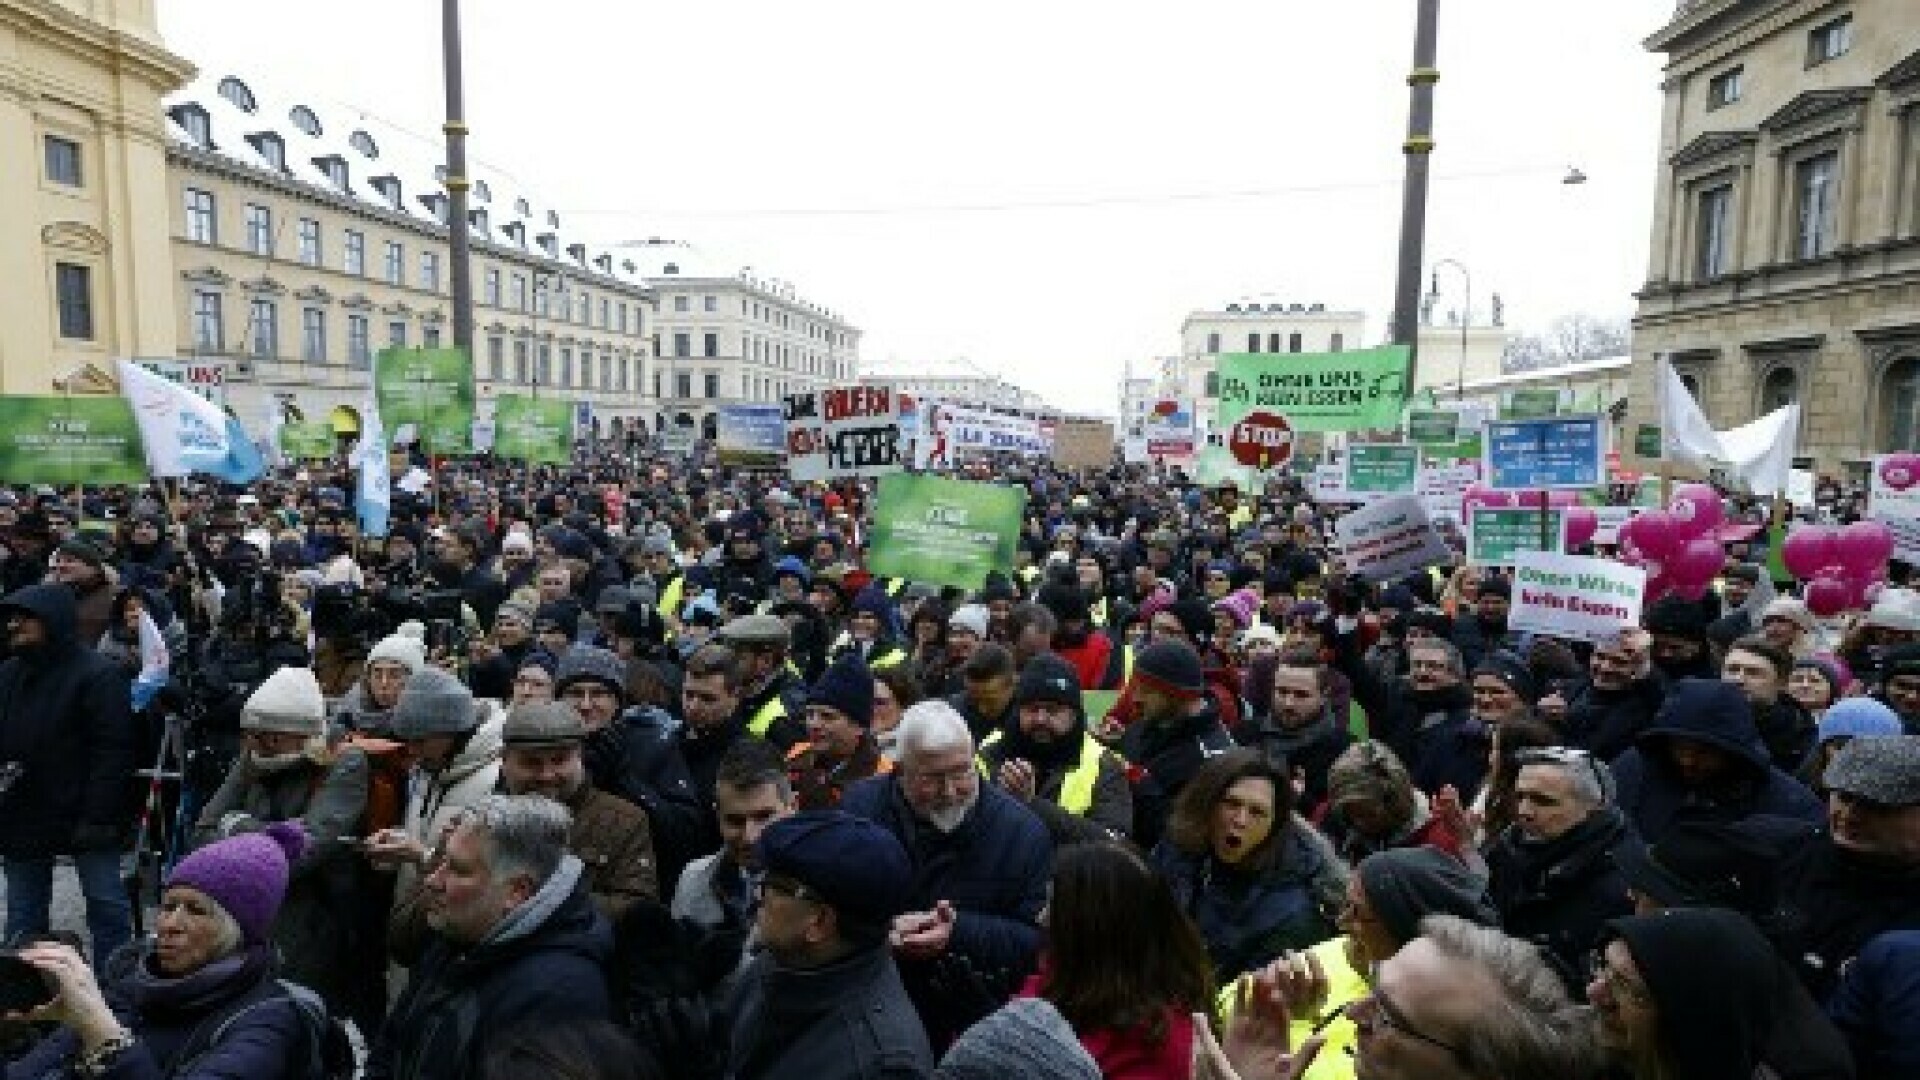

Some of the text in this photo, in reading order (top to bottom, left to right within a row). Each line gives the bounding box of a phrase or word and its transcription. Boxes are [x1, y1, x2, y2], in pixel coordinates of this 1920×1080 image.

[1259, 371, 1363, 387] OHNE UNS
[1309, 389, 1362, 405] ESSEN
[1237, 423, 1291, 447] STOP
[1519, 566, 1572, 586] Ohne
[1522, 589, 1564, 609] kein
